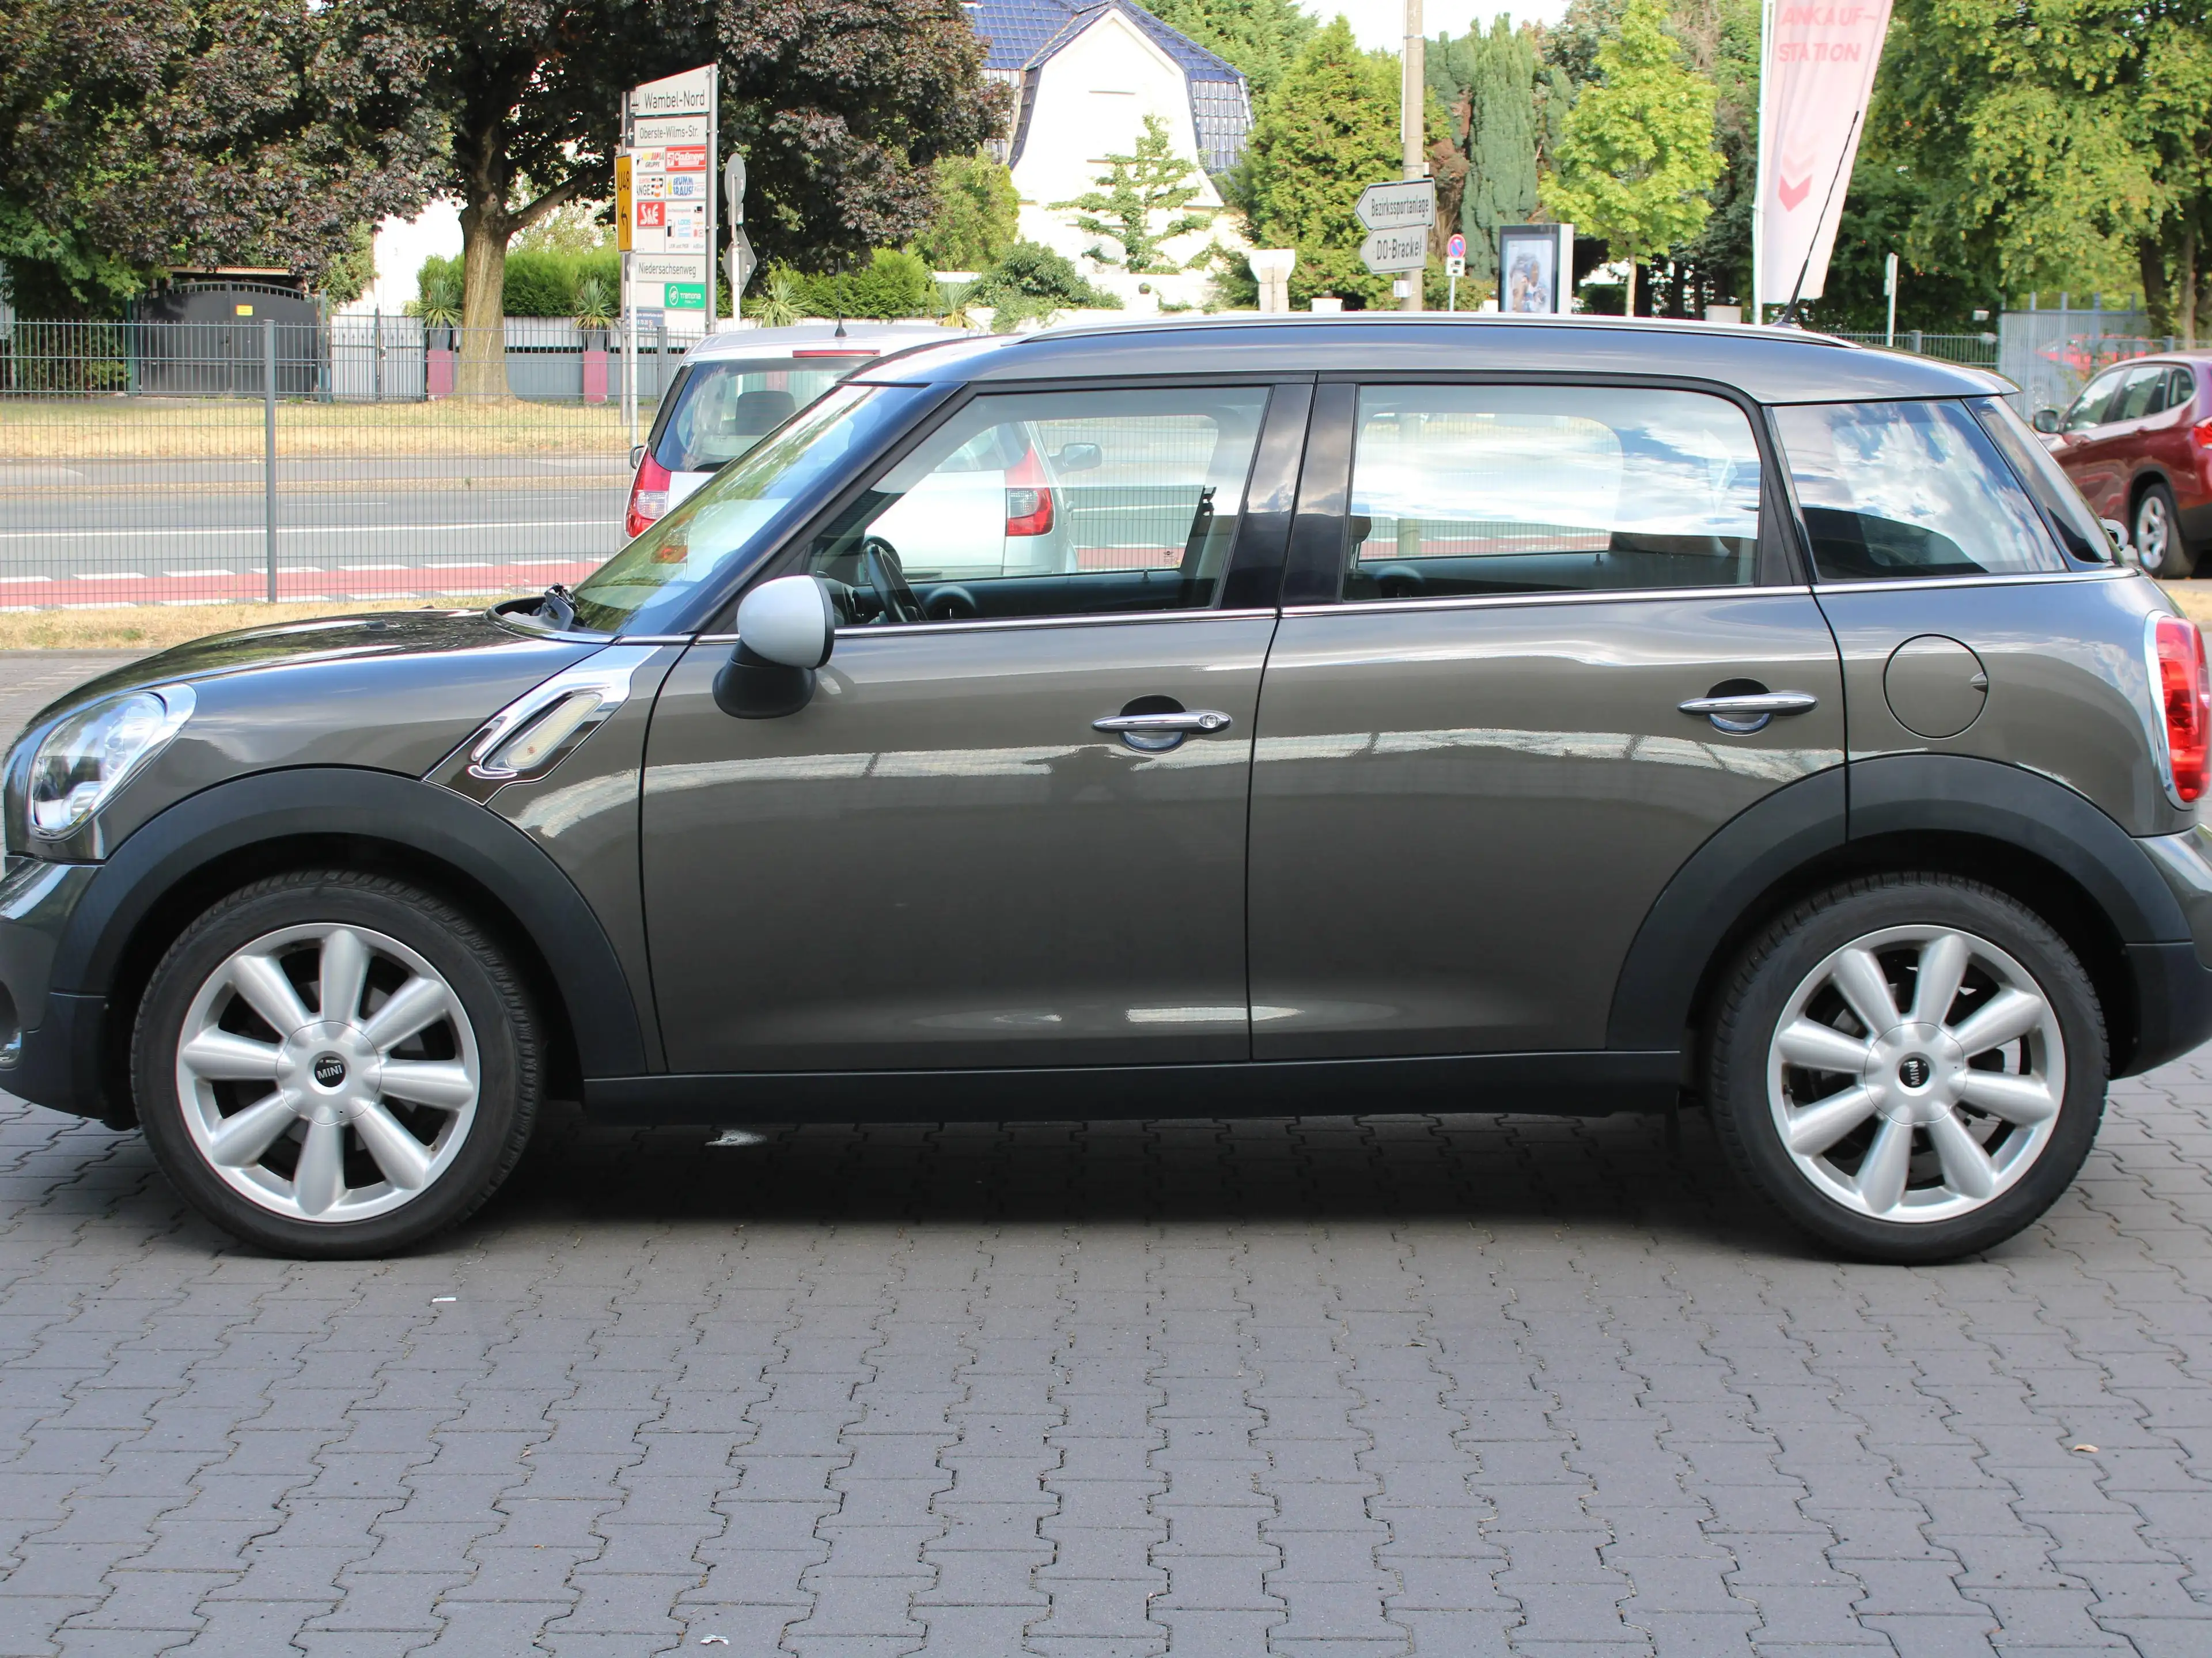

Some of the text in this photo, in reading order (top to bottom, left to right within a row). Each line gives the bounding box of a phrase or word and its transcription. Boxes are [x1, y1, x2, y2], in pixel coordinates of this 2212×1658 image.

[1781, 6, 1877, 26] ANKAUF-
[1778, 42, 1862, 62] STATION
[644, 89, 705, 109] Wambel-Nord
[639, 124, 699, 139] Oberste-Wilms-Str.
[618, 170, 630, 192] U48
[1371, 195, 1429, 220] Bezirkssportanlage
[1377, 234, 1422, 260] DO-Brackel
[638, 262, 696, 278] Niedersachsenweg
[317, 1064, 343, 1080] MINI
[1908, 1060, 1921, 1086] MINI
